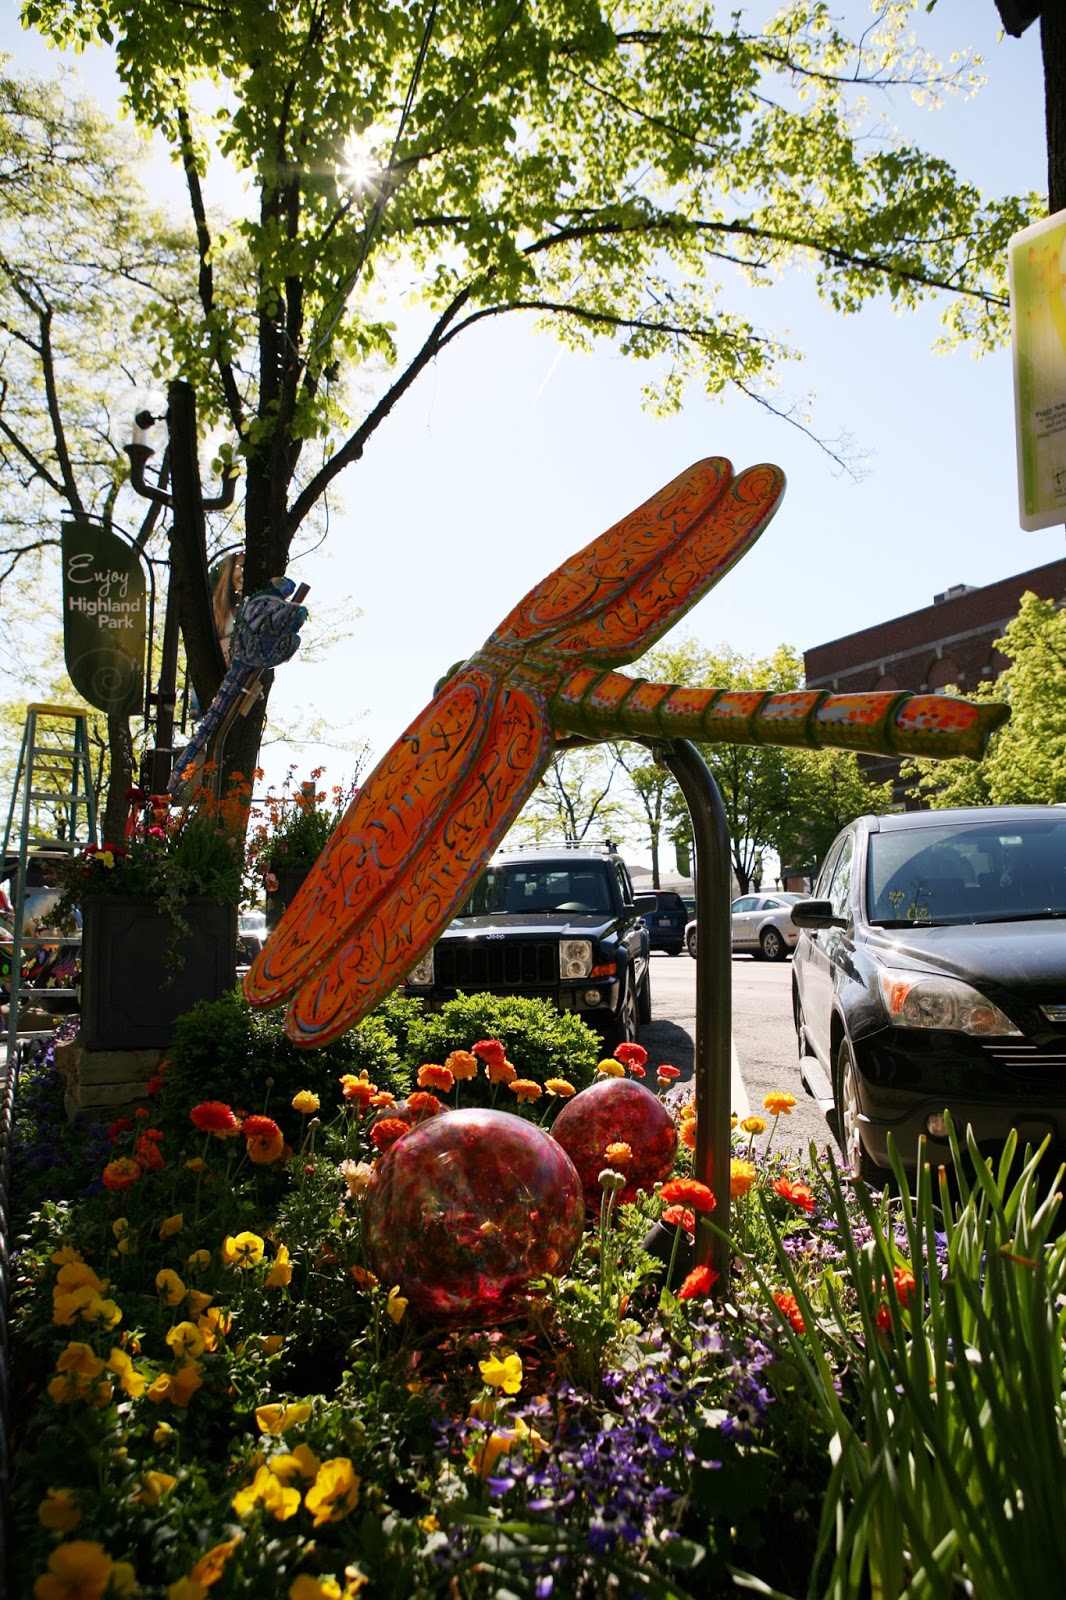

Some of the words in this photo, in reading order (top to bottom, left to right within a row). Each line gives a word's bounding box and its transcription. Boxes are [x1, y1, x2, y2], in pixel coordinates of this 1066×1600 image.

[67, 553, 129, 598] Enjoy
[69, 596, 141, 616] Highland
[98, 614, 135, 629] Park
[486, 933, 506, 941] Jeep
